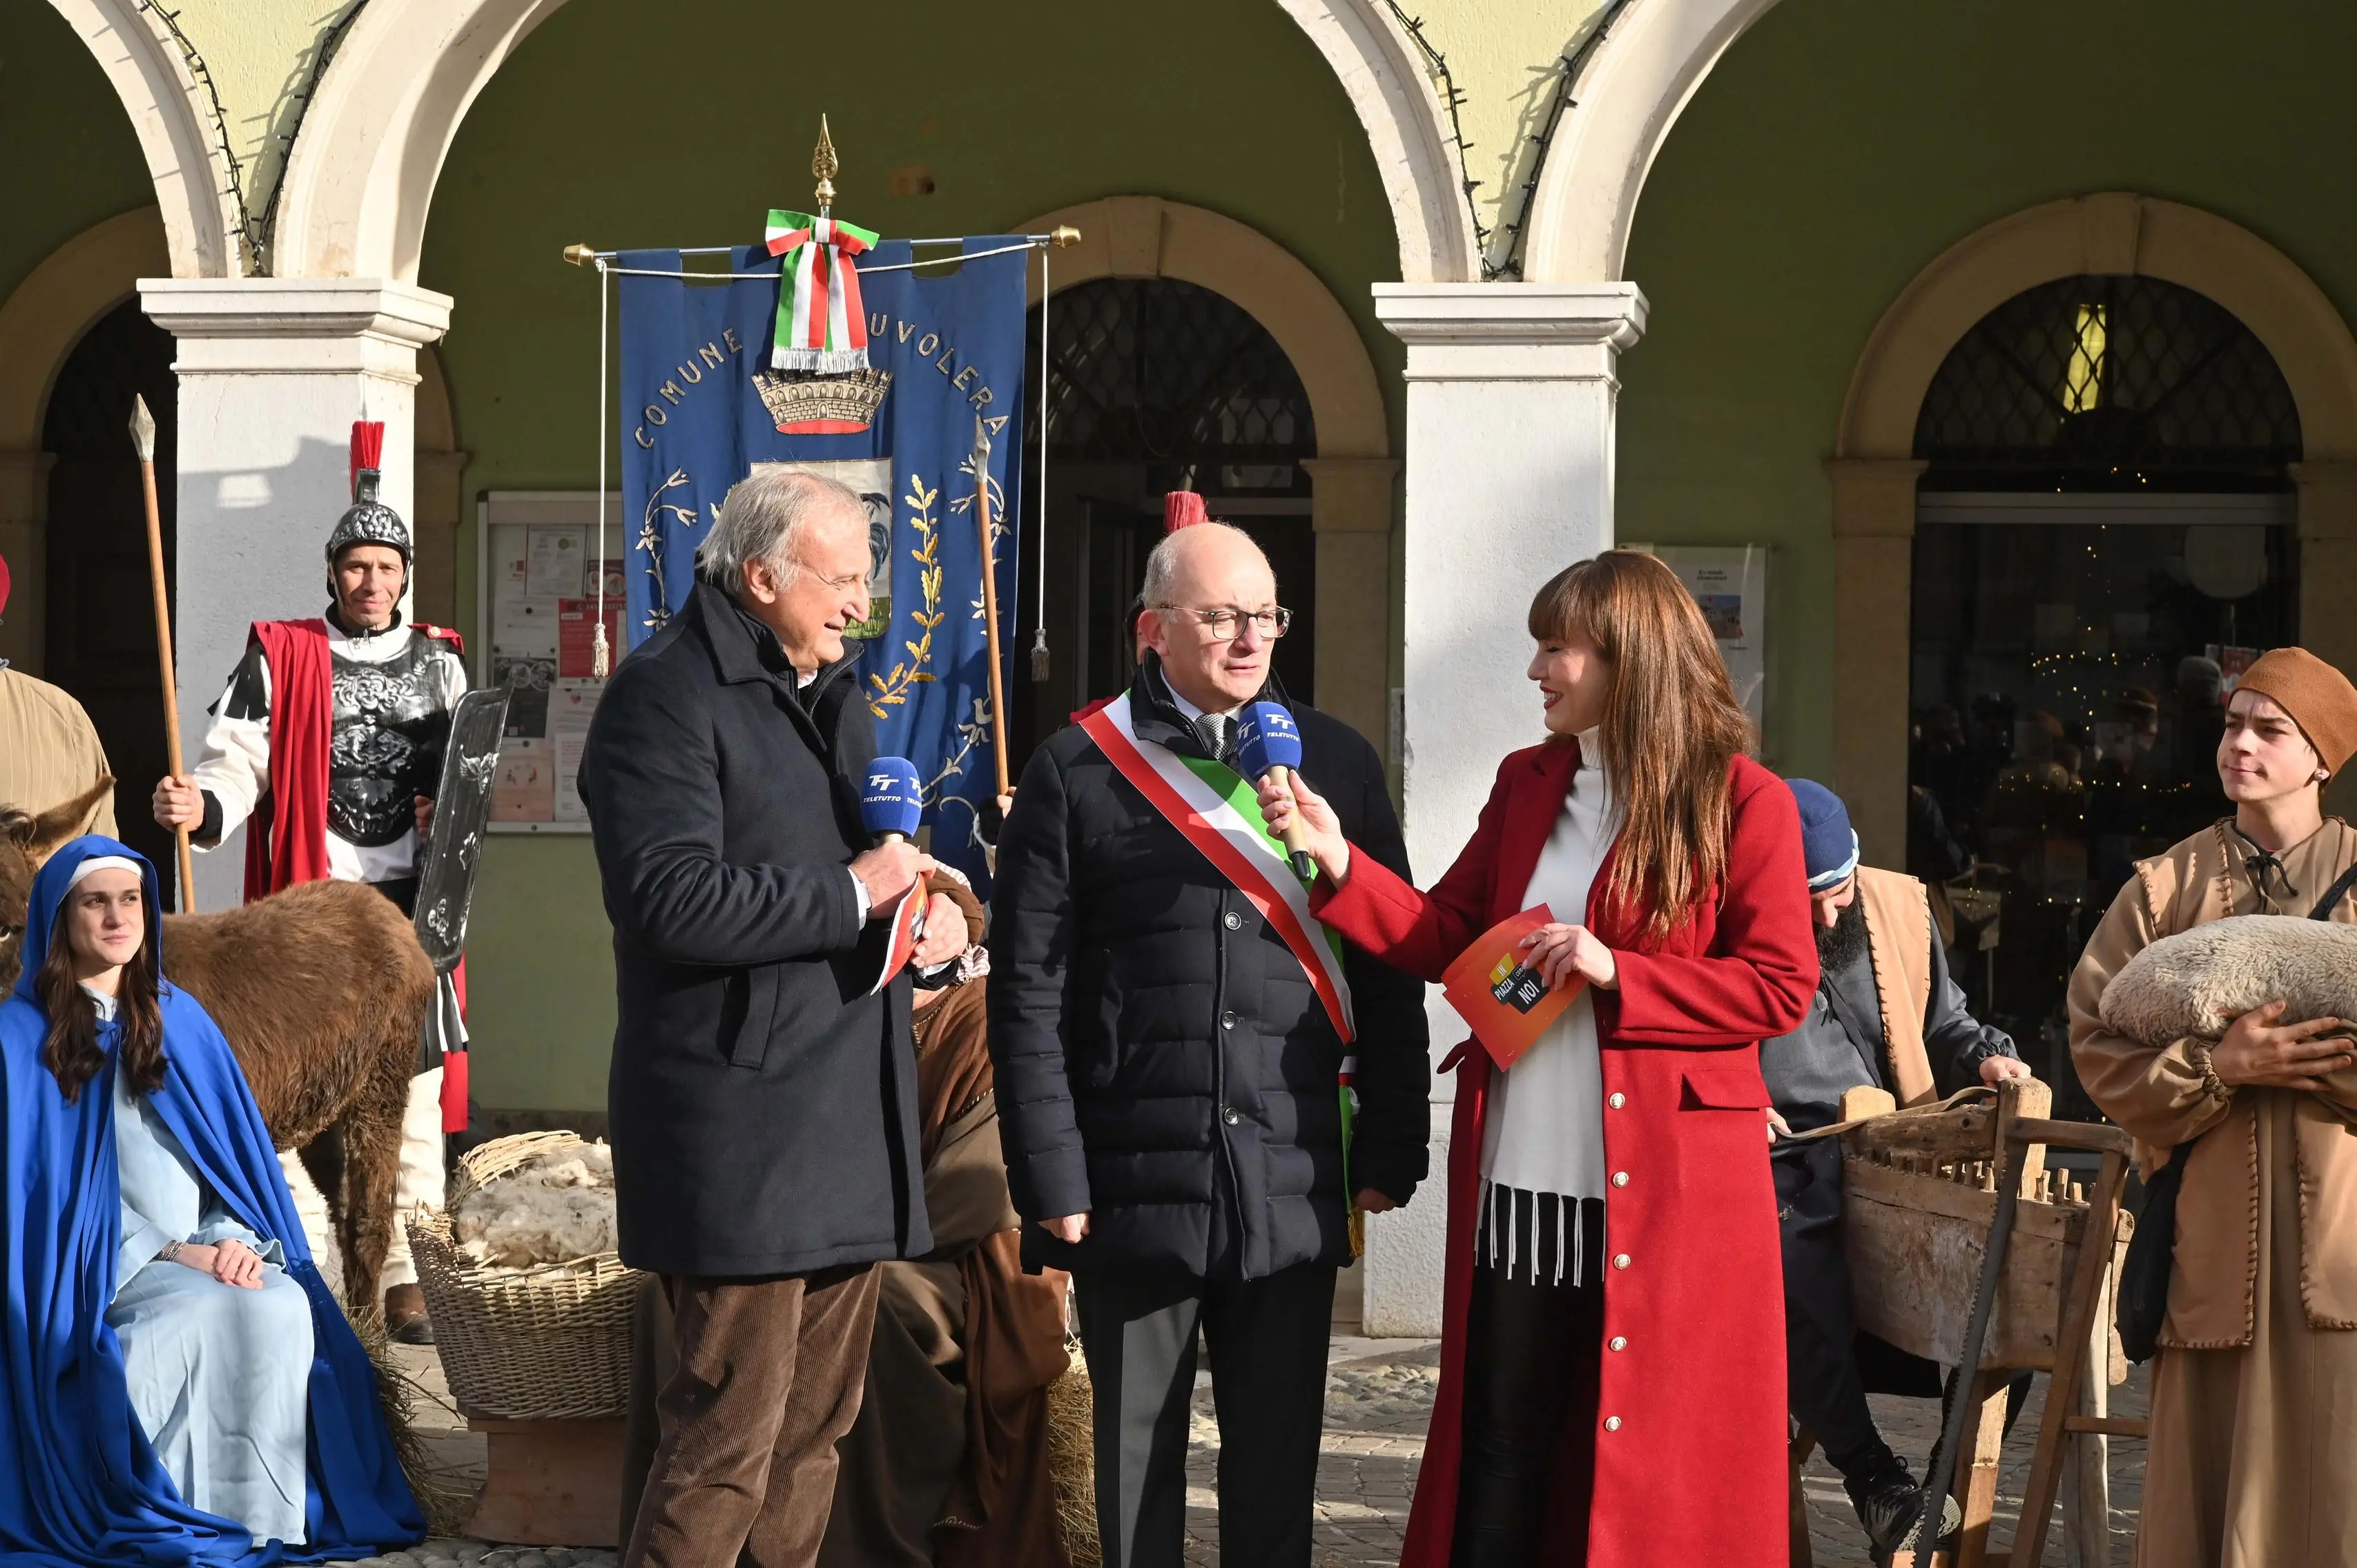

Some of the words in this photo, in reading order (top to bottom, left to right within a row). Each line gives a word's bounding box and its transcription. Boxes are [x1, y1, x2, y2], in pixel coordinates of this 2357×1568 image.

[635, 327, 742, 448] COMUNE
[870, 312, 1009, 436] UVOLERA
[1266, 732, 1299, 742] TELETUTTO
[1497, 964, 1507, 976] IN
[1494, 978, 1515, 1000] PIAZZA
[1517, 979, 1540, 1005] NOI
